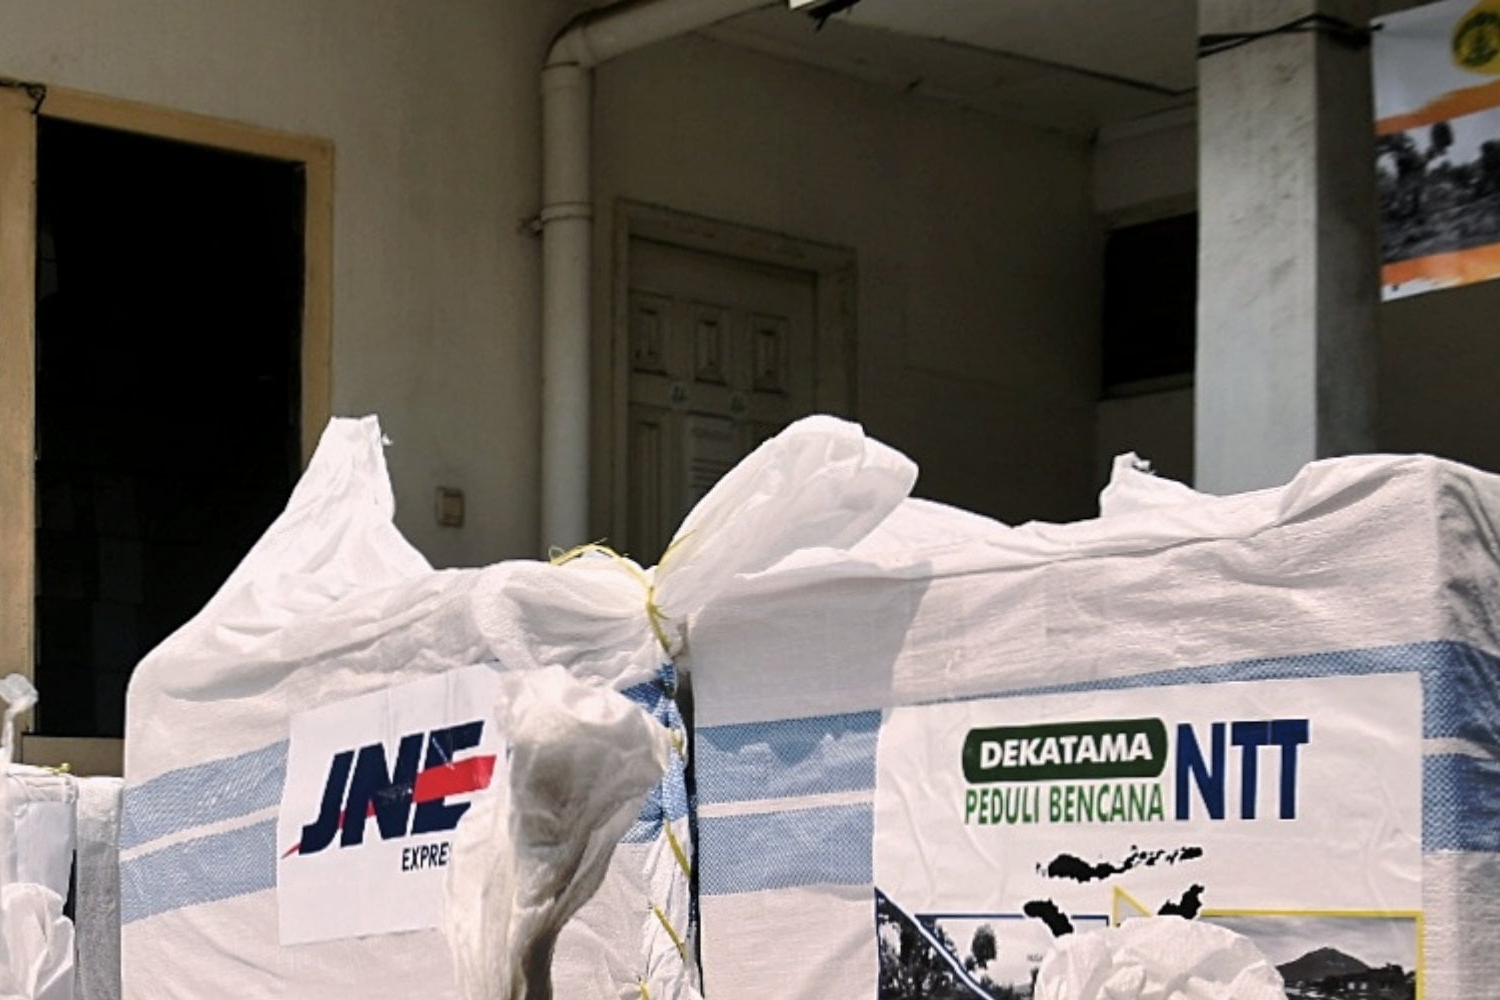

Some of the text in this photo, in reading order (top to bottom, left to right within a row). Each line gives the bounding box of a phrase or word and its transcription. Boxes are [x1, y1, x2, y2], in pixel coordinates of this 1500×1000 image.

[979, 732, 1155, 769] DEKATAMA
[1175, 718, 1310, 820] NTT
[281, 720, 498, 859] JNE
[963, 783, 1165, 825] PEDULI BENCANA
[401, 841, 451, 872] EXPRE
